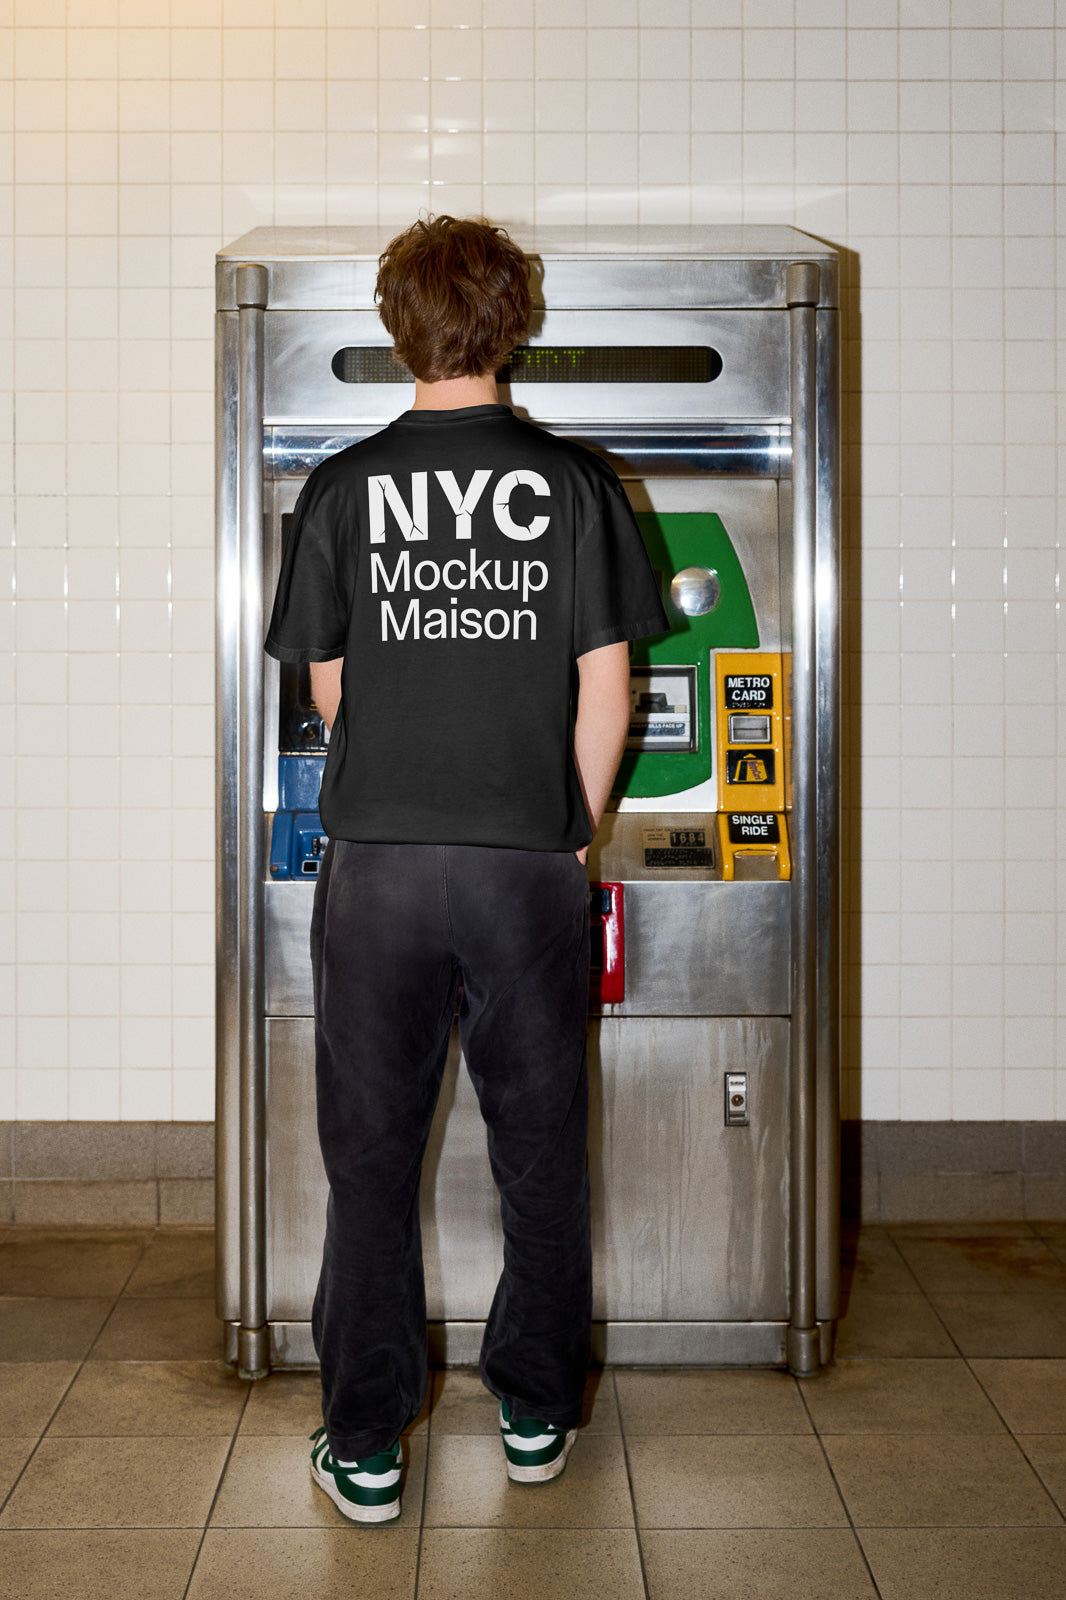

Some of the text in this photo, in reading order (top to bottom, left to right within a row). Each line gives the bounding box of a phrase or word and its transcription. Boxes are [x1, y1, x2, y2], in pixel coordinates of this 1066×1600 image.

[368, 469, 551, 544] NYC
[370, 548, 549, 602] Mockup
[381, 597, 537, 641] Maison
[727, 677, 770, 688] METRO
[732, 689, 767, 701] CARD
[731, 814, 774, 825] SINGLE
[741, 826, 769, 836] RIDE
